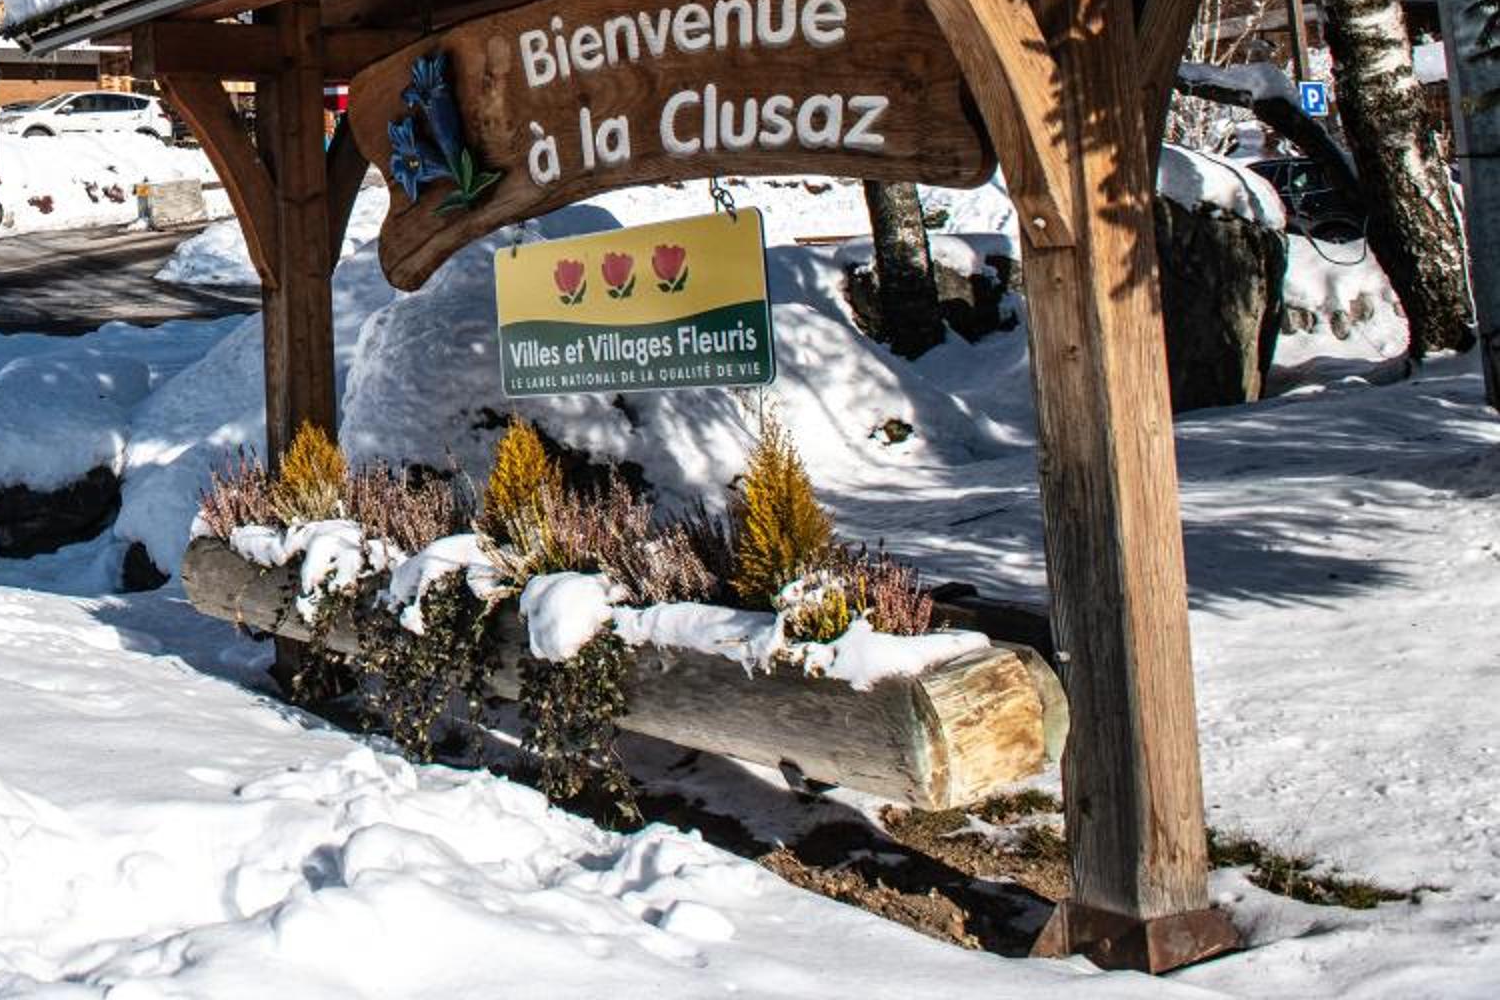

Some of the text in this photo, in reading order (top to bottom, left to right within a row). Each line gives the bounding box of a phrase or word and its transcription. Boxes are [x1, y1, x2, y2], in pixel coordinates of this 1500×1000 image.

[1307, 88, 1320, 109] P
[527, 83, 890, 186] à la Clusaz
[509, 320, 758, 368] Villes et Villages Fleuris
[511, 362, 761, 390] LE LABEL NATIONAL DE LA QUALITÉ DE VIE
